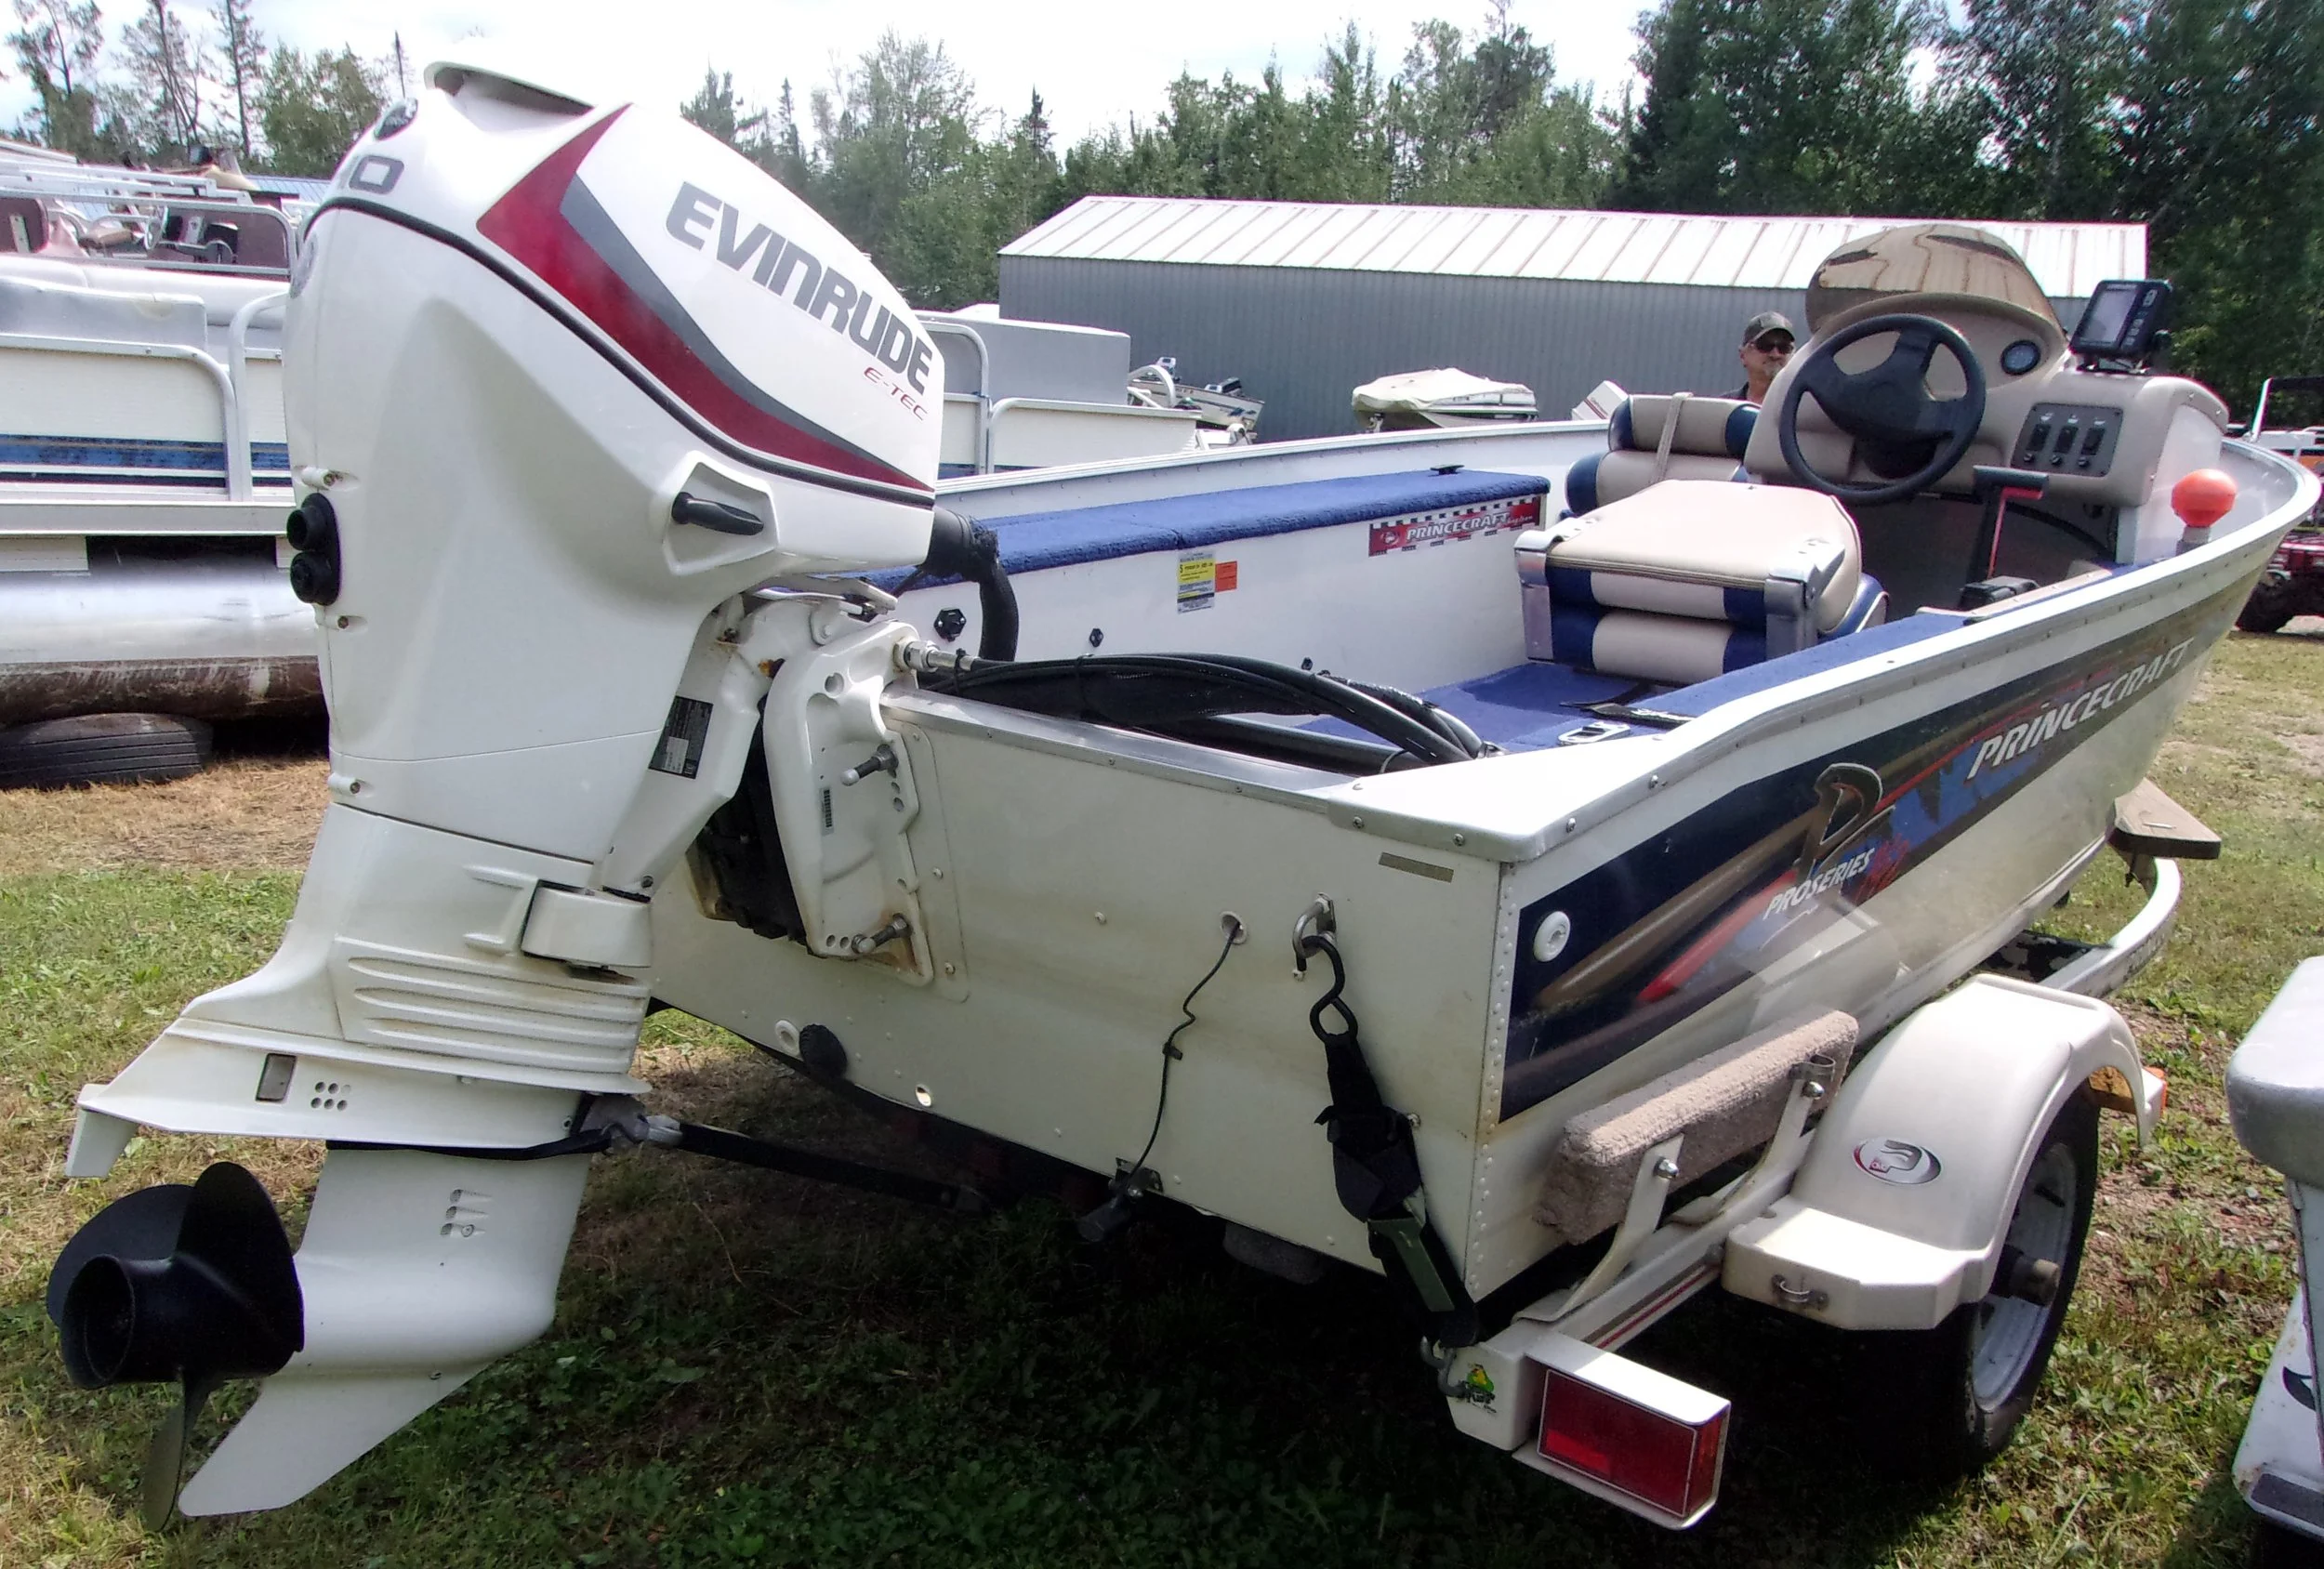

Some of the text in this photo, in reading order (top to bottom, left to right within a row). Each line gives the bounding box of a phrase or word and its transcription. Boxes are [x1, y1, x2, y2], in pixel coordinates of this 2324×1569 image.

[666, 181, 932, 396] EVINRUDE
[864, 366, 928, 421] E-TEC
[1406, 511, 1510, 541] PRINCECRAFT
[1967, 637, 2195, 781] PRINCECRAFT
[1762, 847, 1876, 921] PROSERIES
